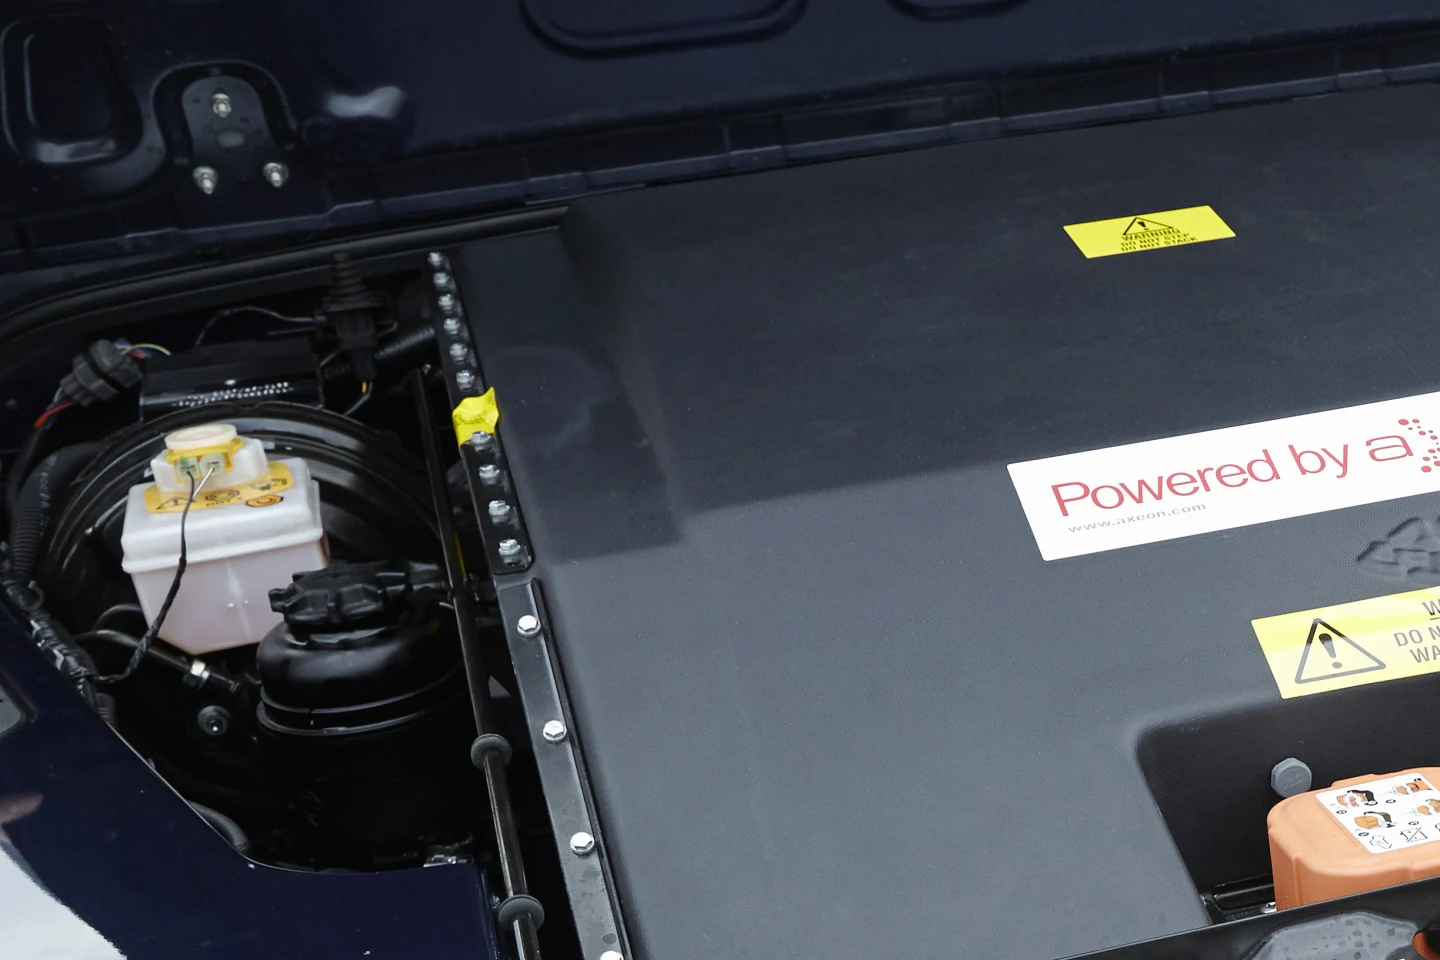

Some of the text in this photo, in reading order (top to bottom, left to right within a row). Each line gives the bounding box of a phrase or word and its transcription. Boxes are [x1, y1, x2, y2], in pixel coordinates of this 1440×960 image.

[1121, 228, 1181, 242] WARNING
[1050, 457, 1280, 517] Powered
[1289, 441, 1350, 479] by
[1067, 502, 1208, 534] www.axeon.com
[1393, 629, 1422, 647] DO
